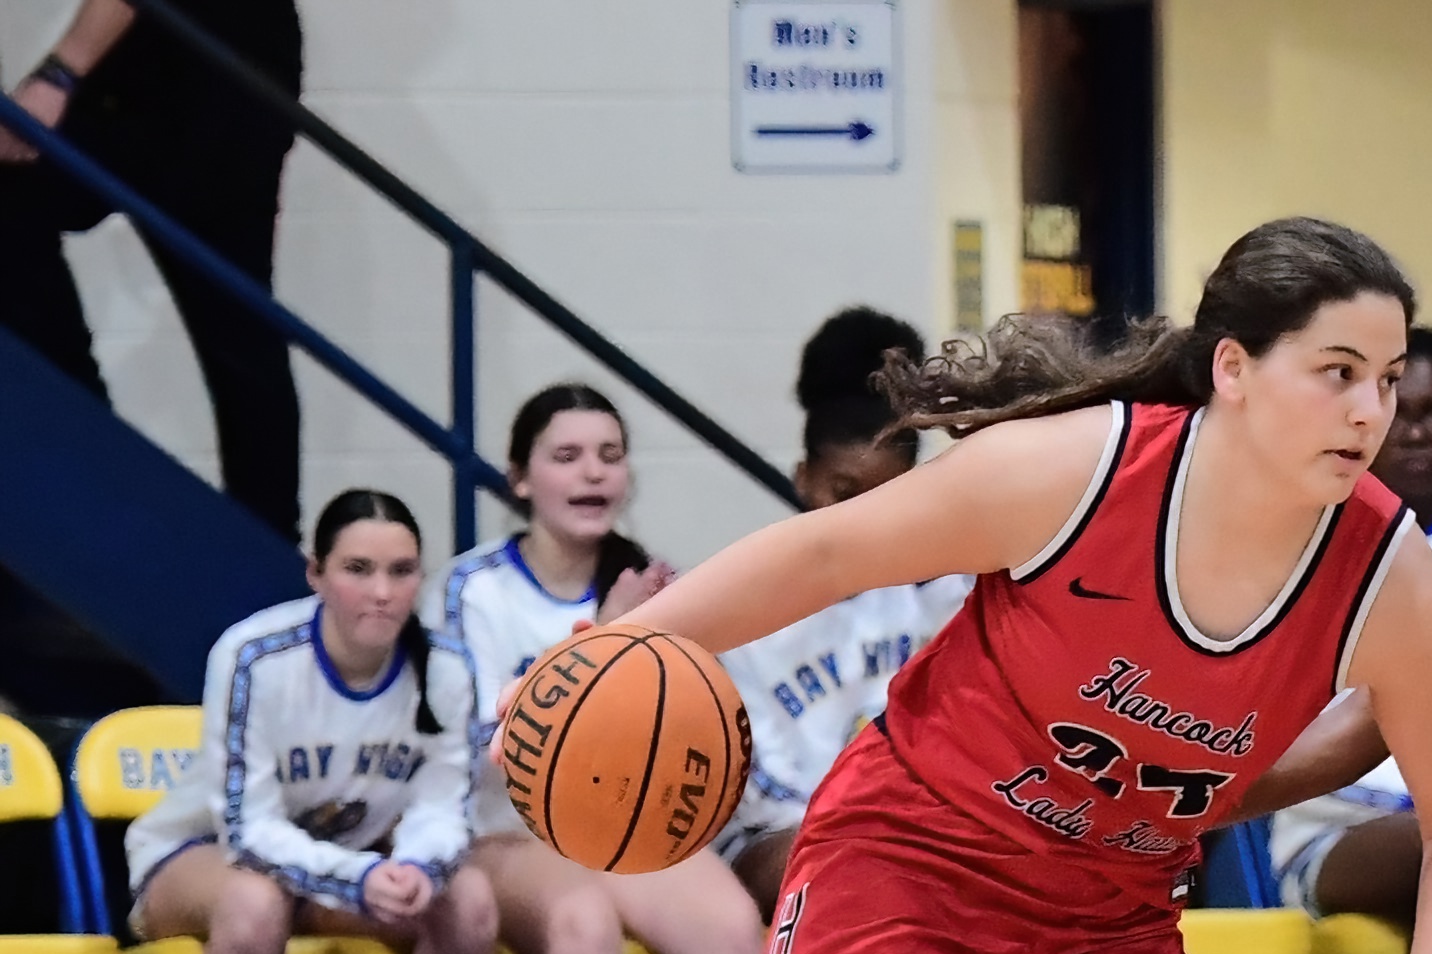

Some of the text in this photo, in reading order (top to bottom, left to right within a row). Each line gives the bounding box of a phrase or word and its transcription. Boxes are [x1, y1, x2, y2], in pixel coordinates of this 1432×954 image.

[773, 652, 843, 720] BAY
[1079, 656, 1259, 758] Hancock
[666, 746, 711, 840] EVO
[991, 766, 1097, 839] Lady
